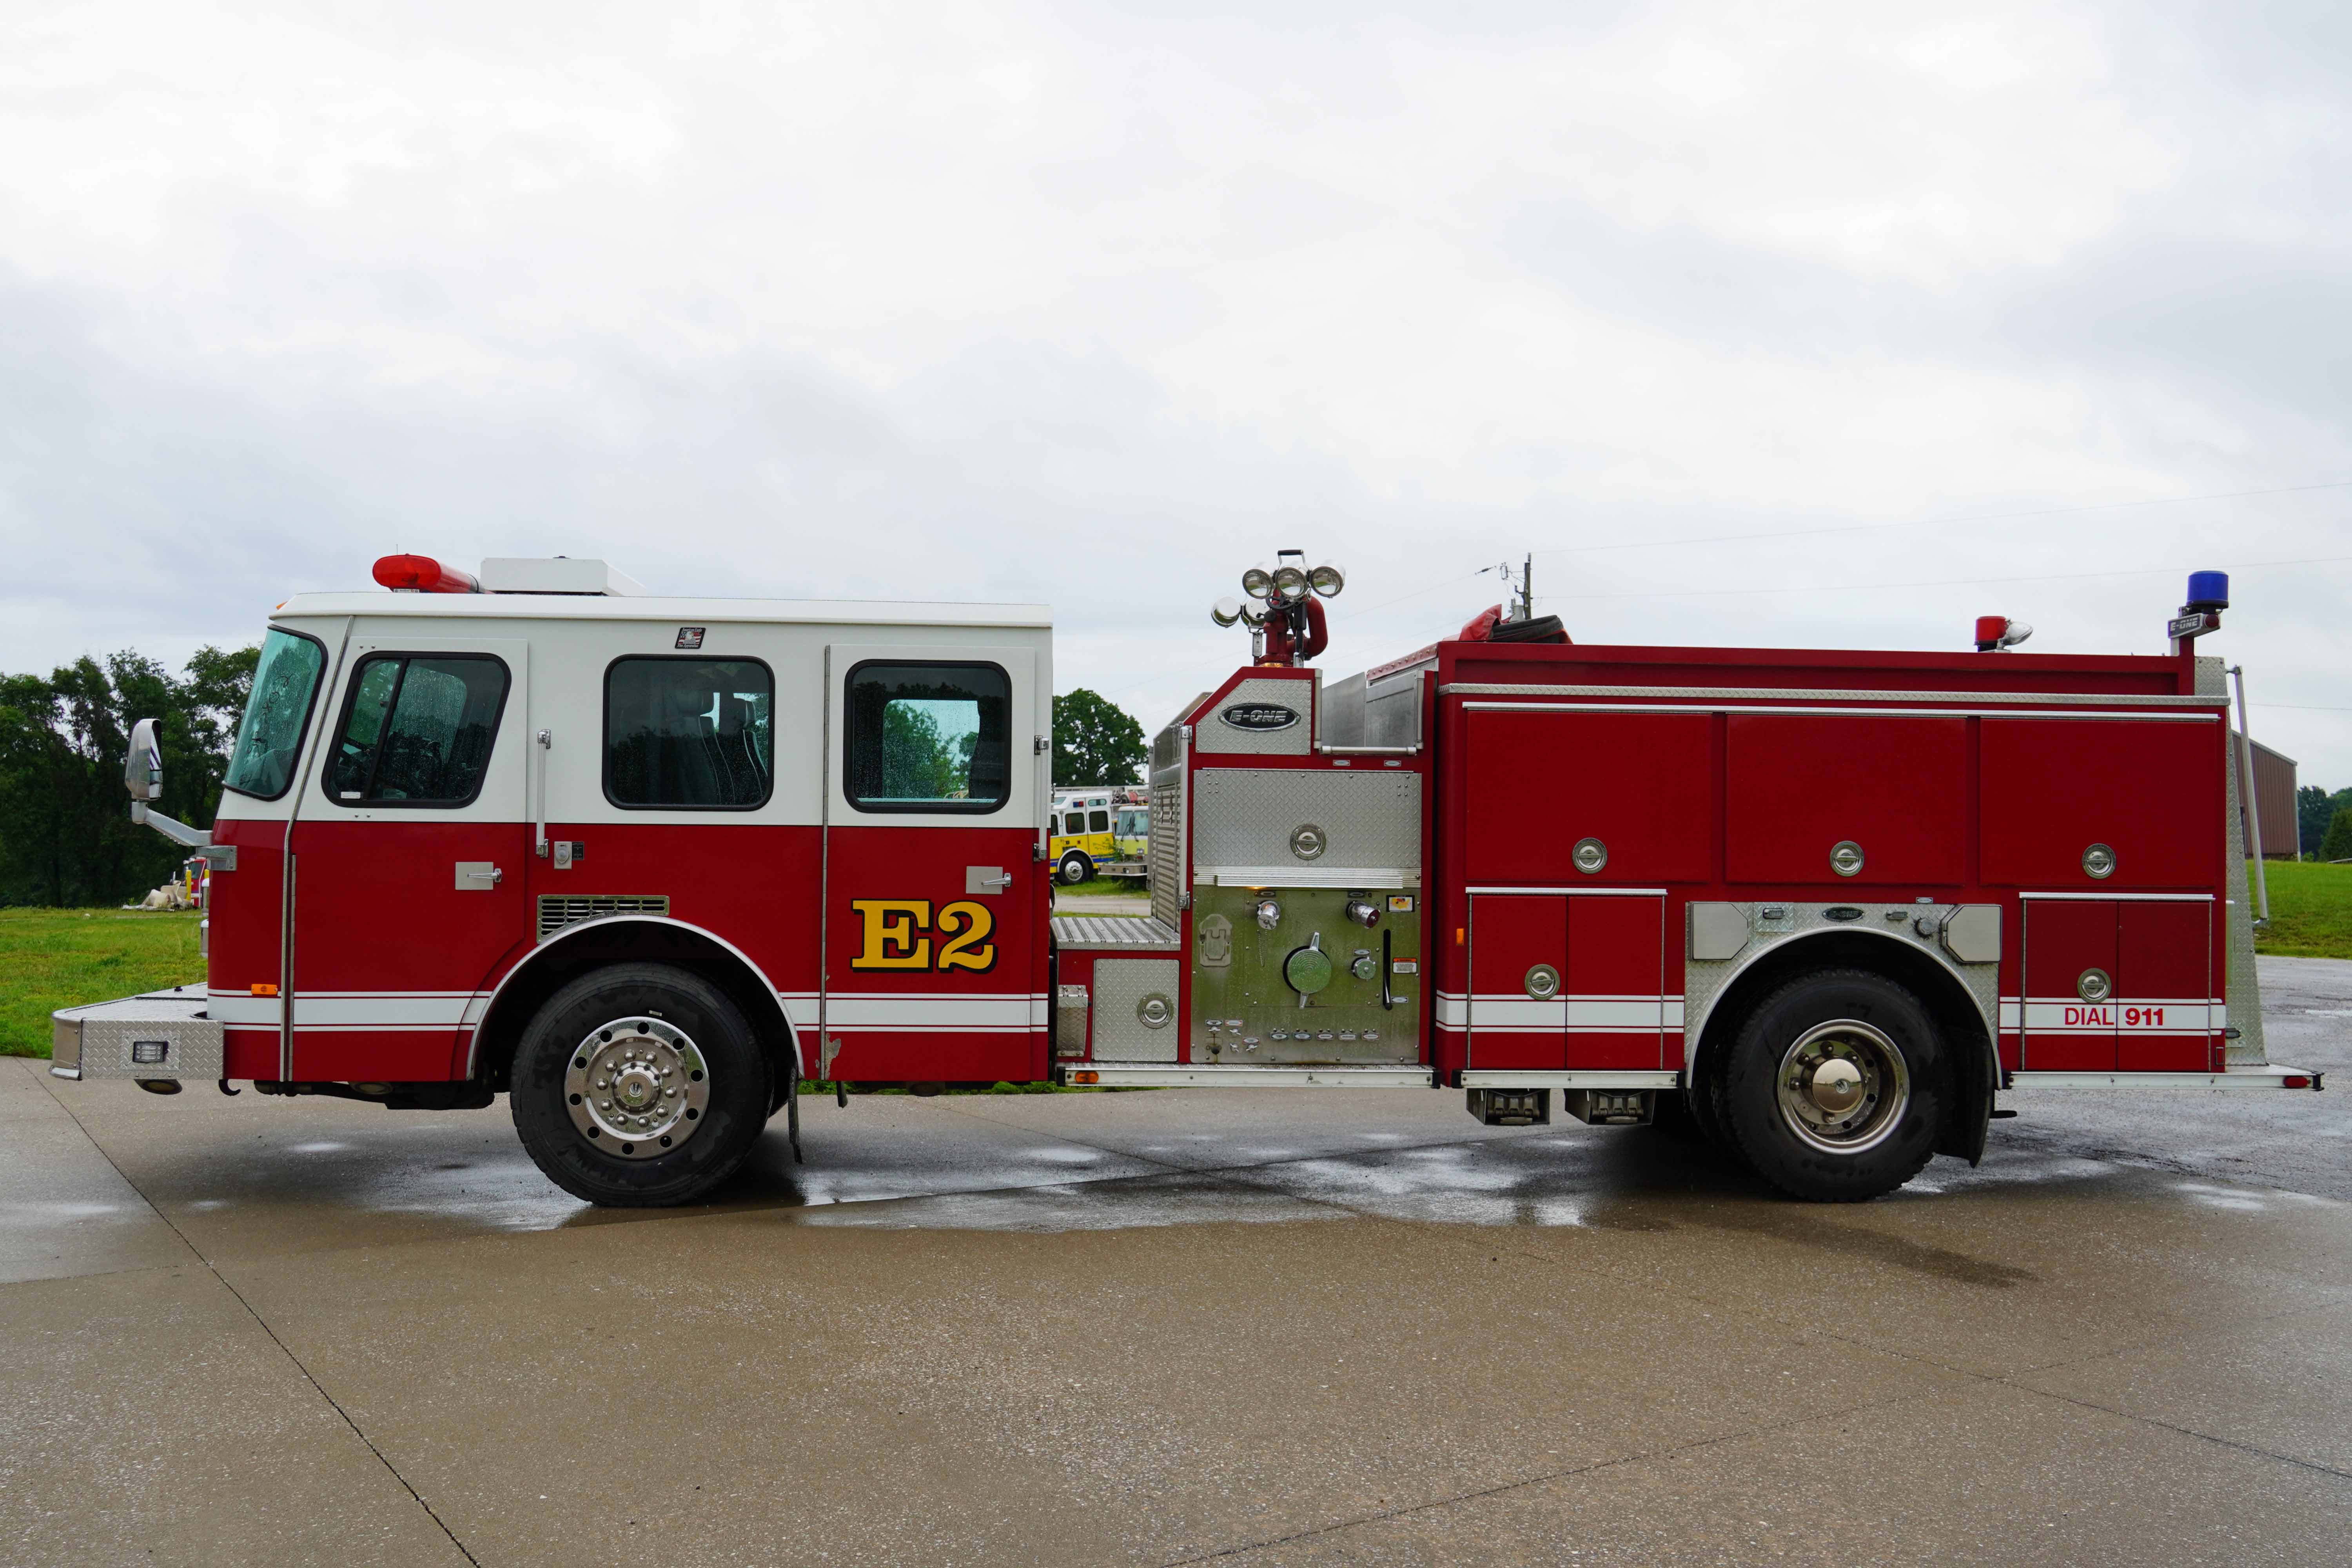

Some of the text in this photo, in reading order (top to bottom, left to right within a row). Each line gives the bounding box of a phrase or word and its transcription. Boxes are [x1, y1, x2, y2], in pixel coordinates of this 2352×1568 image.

[2170, 617, 2198, 631] E-ONE
[1229, 710, 1288, 722] E-ONE
[850, 898, 998, 975] E2
[2064, 1007, 2163, 1026] DIAL 911
